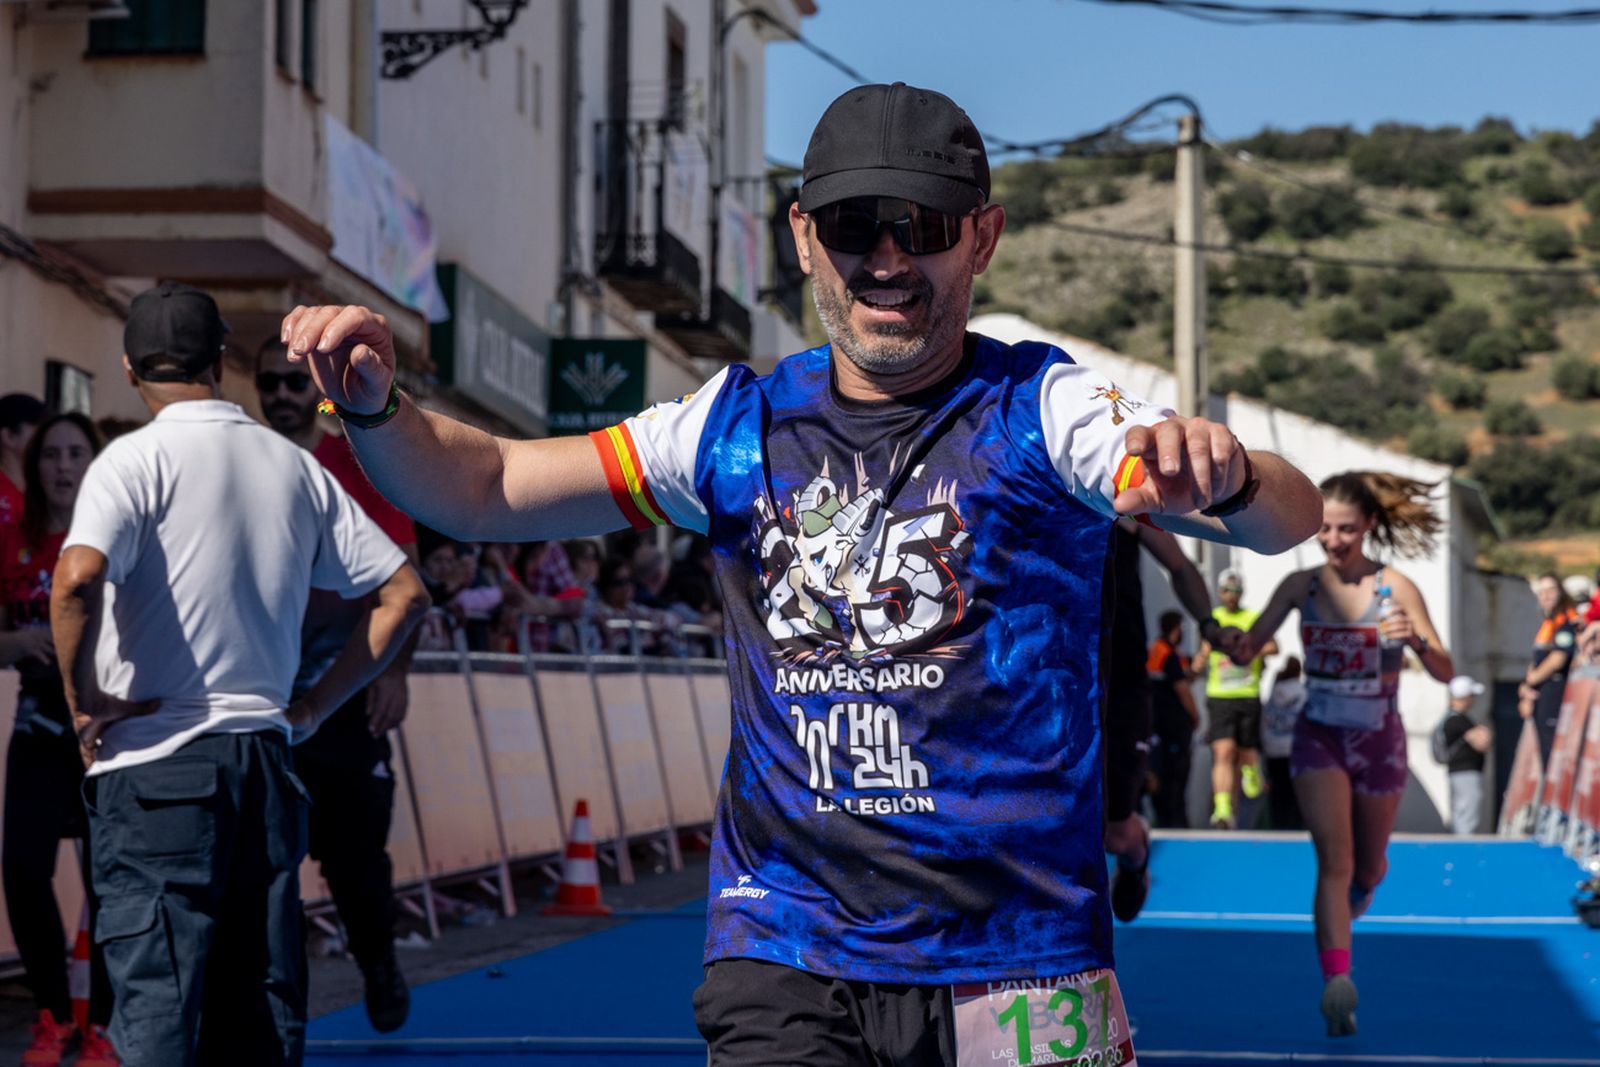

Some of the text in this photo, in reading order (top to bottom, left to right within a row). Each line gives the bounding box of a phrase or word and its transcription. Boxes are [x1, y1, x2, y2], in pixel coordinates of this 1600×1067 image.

[1313, 648, 1365, 673] 734
[774, 663, 945, 693] ANIVERSARIO
[844, 794, 935, 815] LEGIÓN
[998, 975, 1110, 1066] 137
[991, 1048, 1014, 1060] LAS
